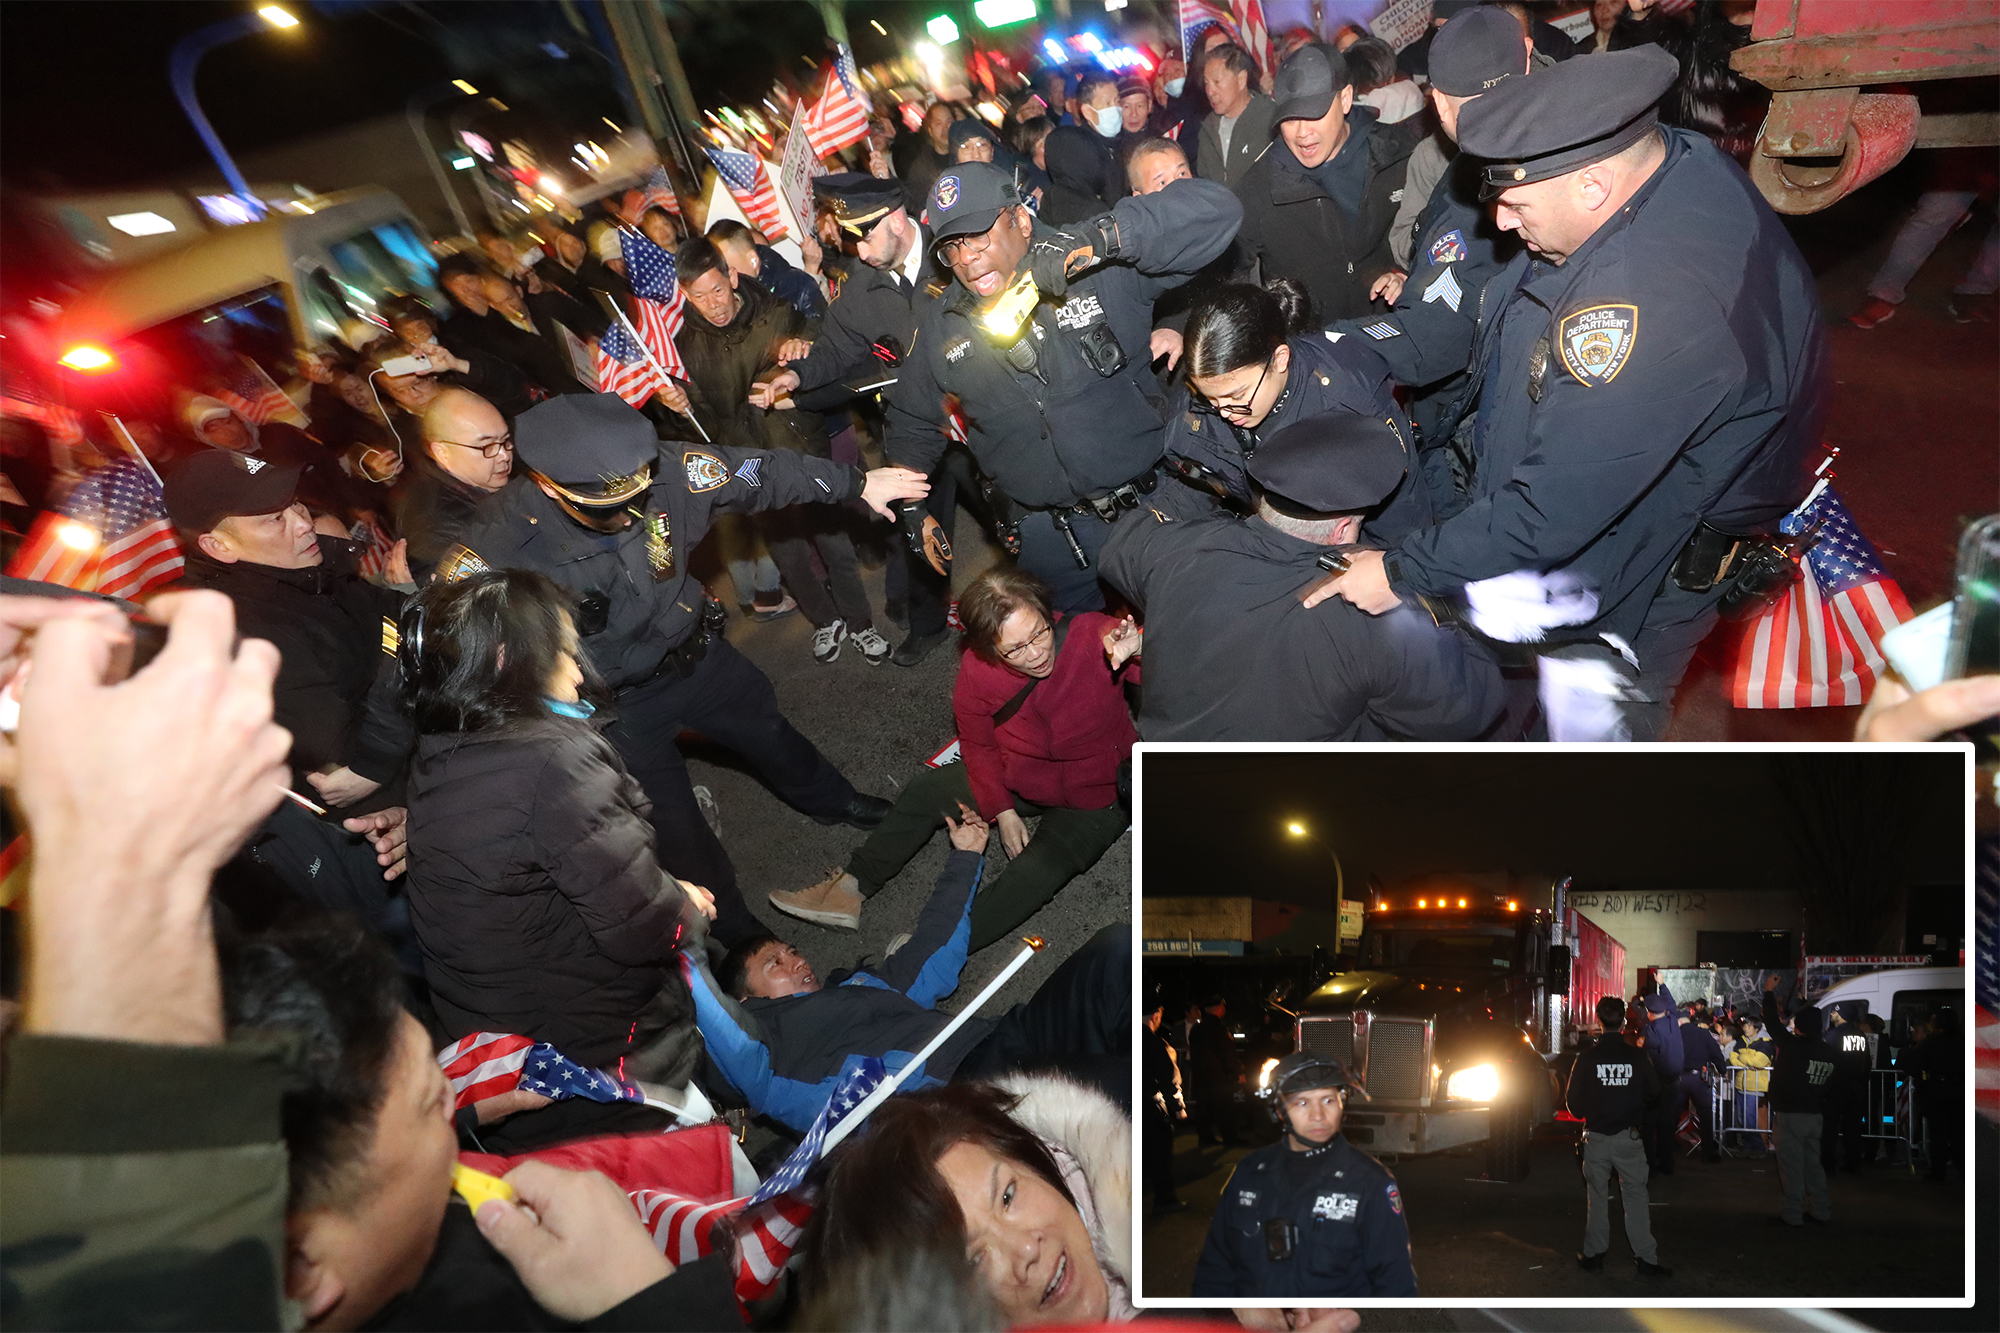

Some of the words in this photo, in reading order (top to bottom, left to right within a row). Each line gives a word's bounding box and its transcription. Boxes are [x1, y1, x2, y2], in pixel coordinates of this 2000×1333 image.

[1380, 0, 1413, 25] CHILD
[1483, 72, 1510, 88] NY
[1431, 233, 1457, 255] POLICE
[1055, 295, 1099, 321] POLICE
[1579, 310, 1615, 325] POLICE
[1566, 318, 1629, 338] DEPARTMENT
[1565, 347, 1580, 367] CITY
[1576, 366, 1590, 378] OF
[1601, 359, 1619, 379] NEW
[1614, 333, 1632, 360] YORK
[941, 751, 962, 766] Saf
[1570, 894, 1599, 908] WILD
[1602, 894, 1629, 914] BOY
[1842, 1035, 1866, 1051] NYPD
[1596, 1063, 1633, 1079] NYPD
[1806, 1060, 1835, 1077] NYPD
[1600, 1077, 1630, 1086] TARU
[1315, 1196, 1358, 1212] POLICE
